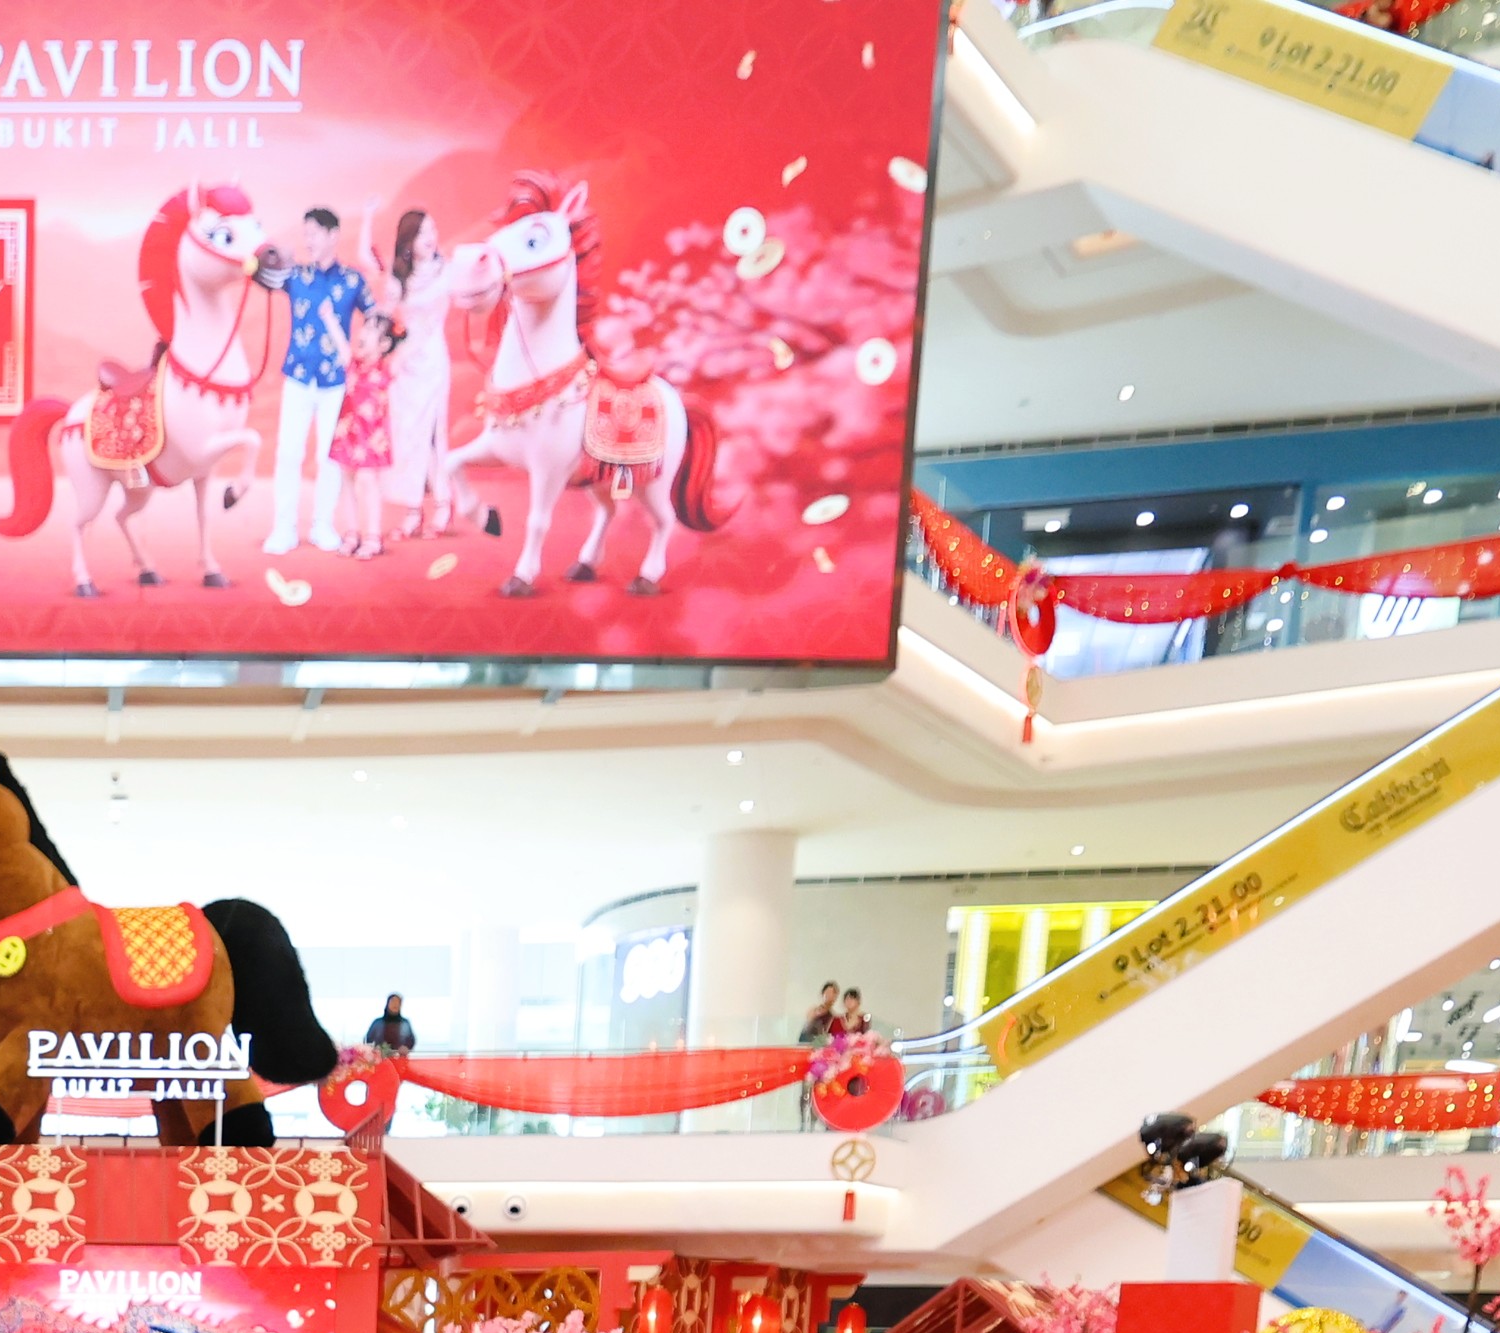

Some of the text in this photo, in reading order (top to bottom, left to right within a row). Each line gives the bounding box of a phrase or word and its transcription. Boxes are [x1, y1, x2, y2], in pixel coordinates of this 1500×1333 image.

[156, 118, 267, 151] JALIL
[1132, 930, 1172, 966] Lot
[28, 1031, 253, 1068] PAVILION
[52, 1078, 226, 1101] BUKIT JALIL
[59, 1269, 203, 1296] PAVILION
